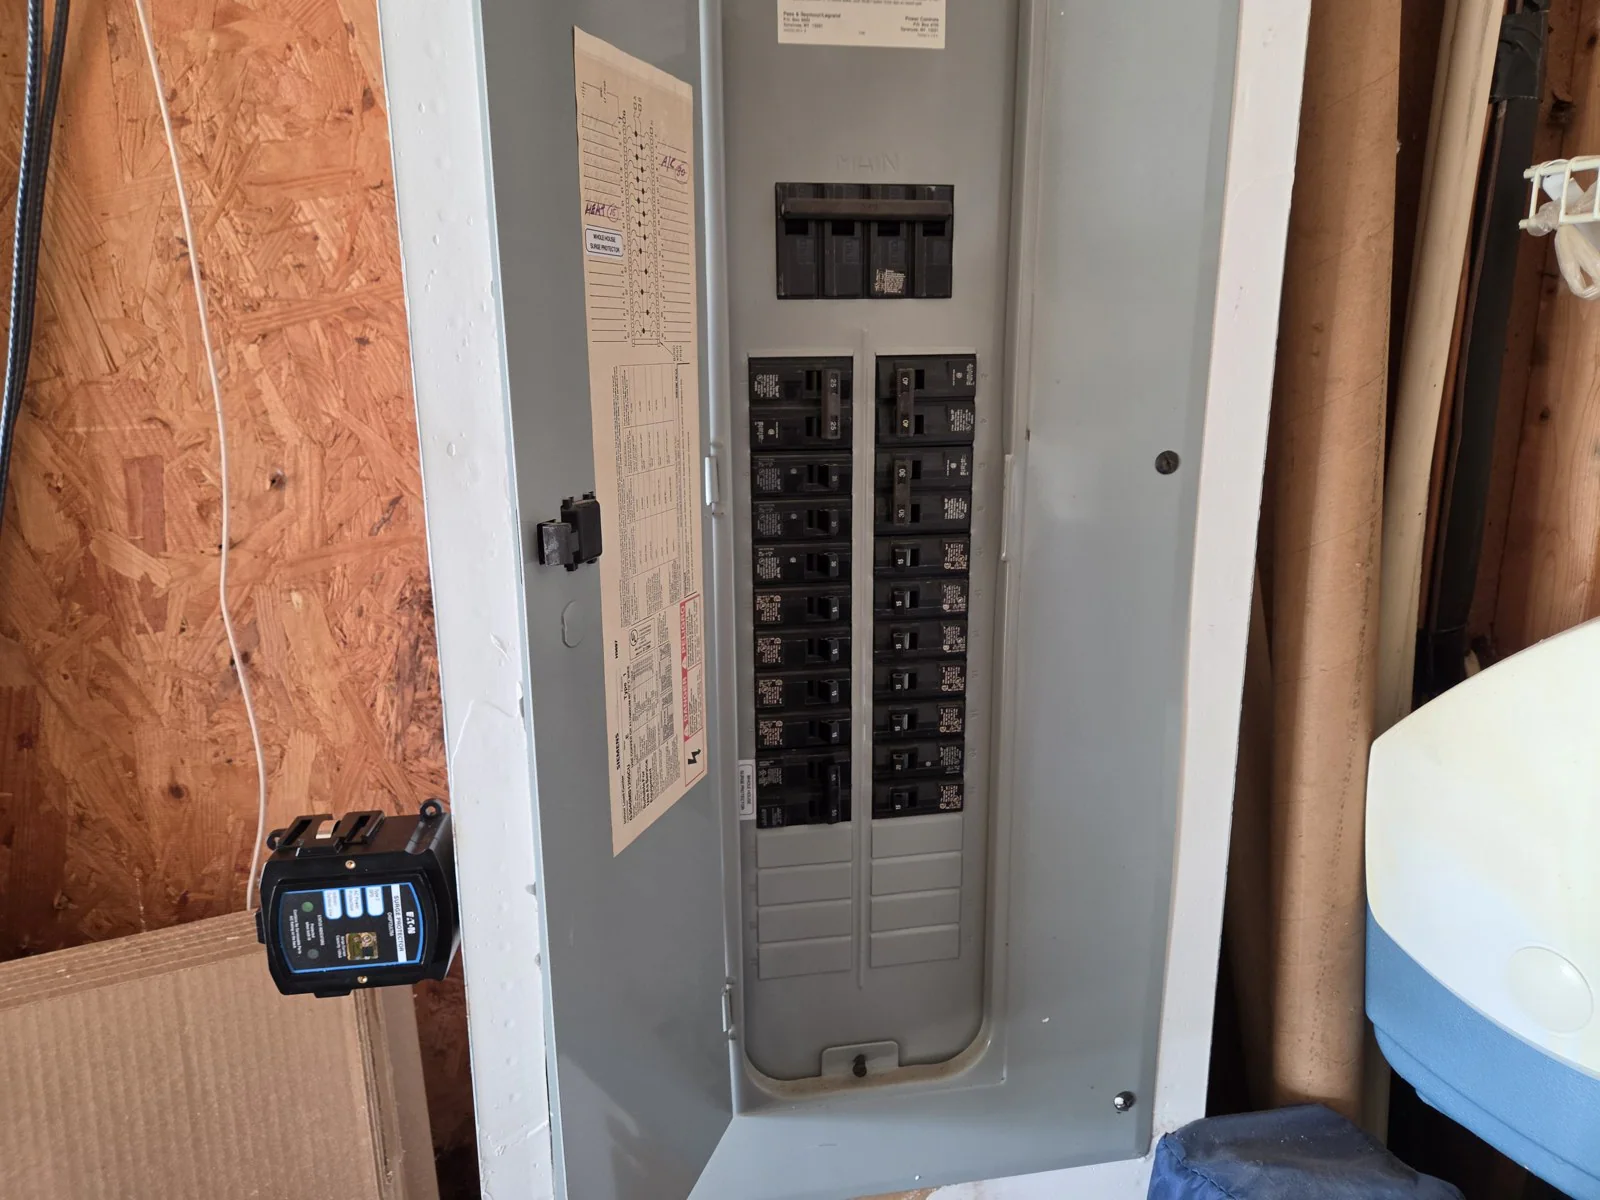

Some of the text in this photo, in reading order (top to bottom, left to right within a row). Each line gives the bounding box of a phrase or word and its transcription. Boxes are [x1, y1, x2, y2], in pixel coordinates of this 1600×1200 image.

[836, 152, 898, 174] MAIN
[585, 202, 605, 217] HEAT
[406, 911, 415, 934] EATON
[395, 917, 404, 952] PROTECTOR
